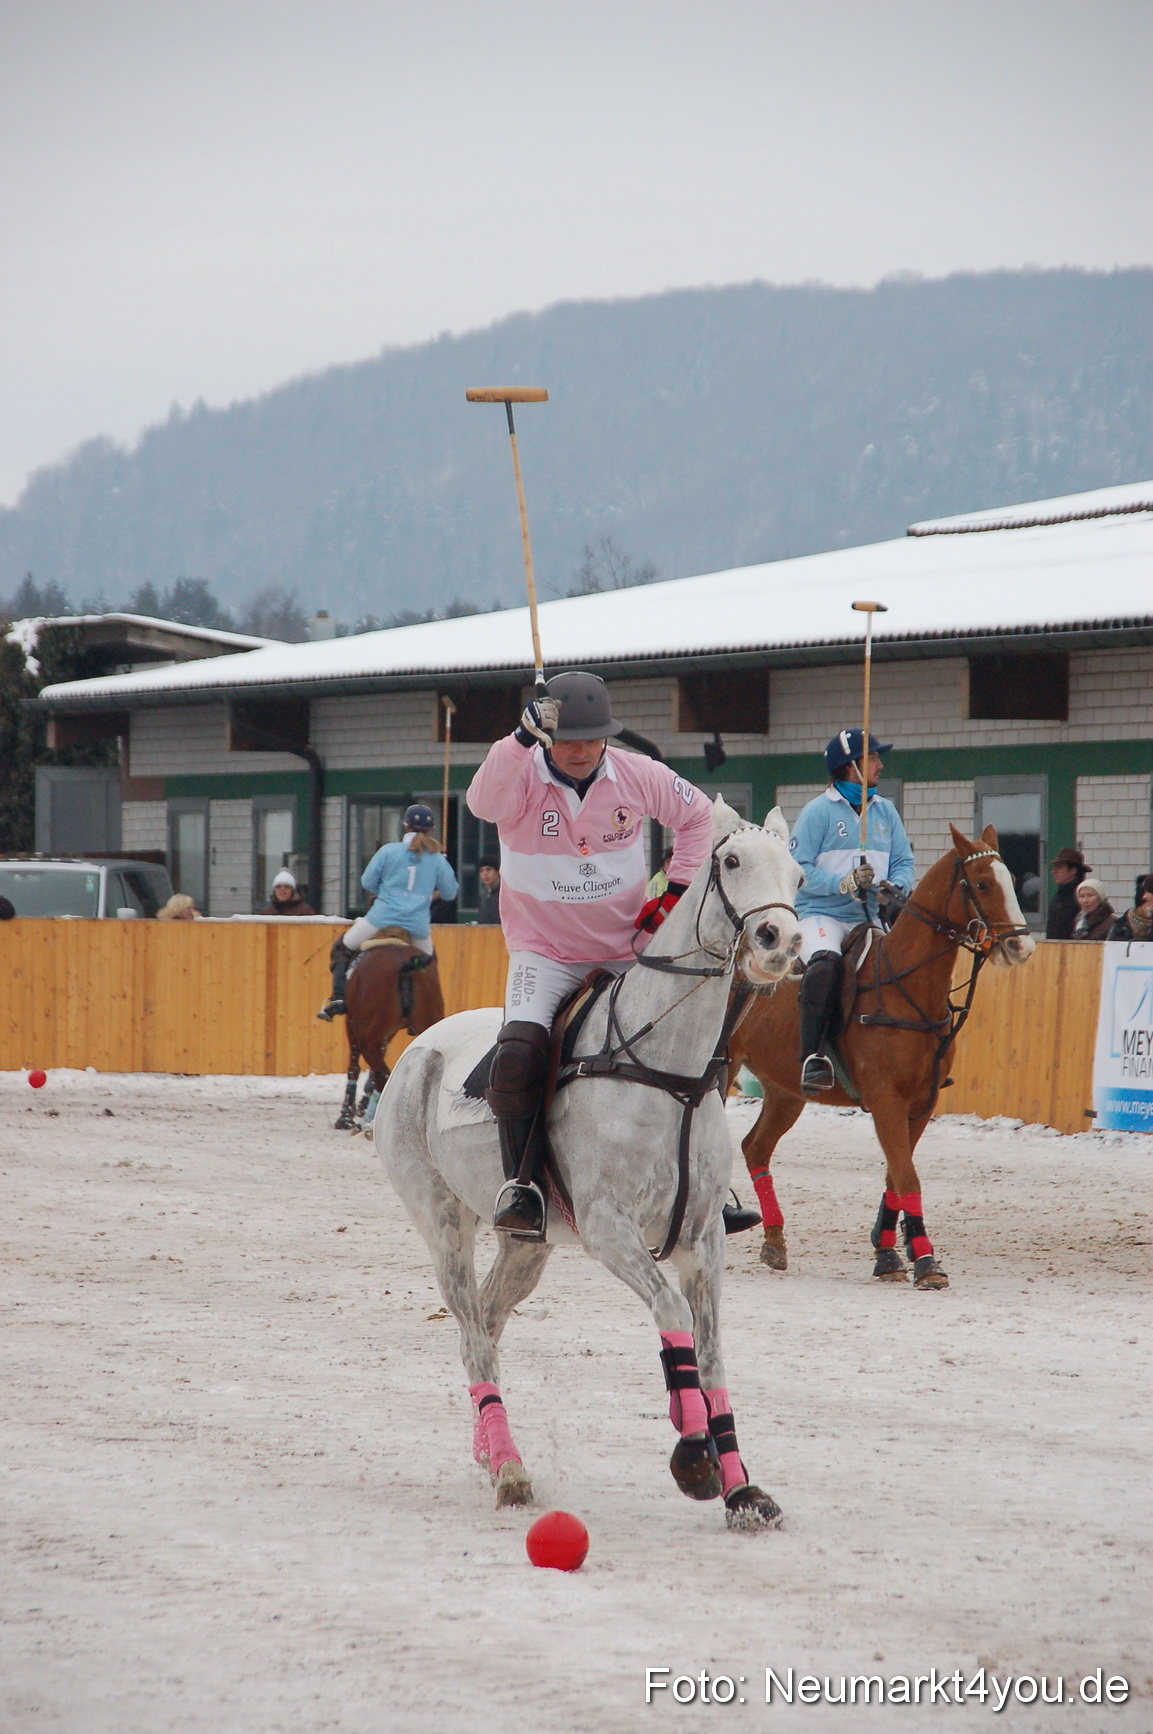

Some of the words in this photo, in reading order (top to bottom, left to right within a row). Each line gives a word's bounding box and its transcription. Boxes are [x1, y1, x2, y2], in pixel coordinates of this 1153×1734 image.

[673, 775, 694, 805] 2
[542, 810, 560, 837] 2
[836, 820, 849, 838] 2
[406, 865, 416, 891] 1
[551, 880, 581, 893] Veuve
[583, 877, 621, 892] Clicquot
[1123, 1029, 1153, 1056] MEY
